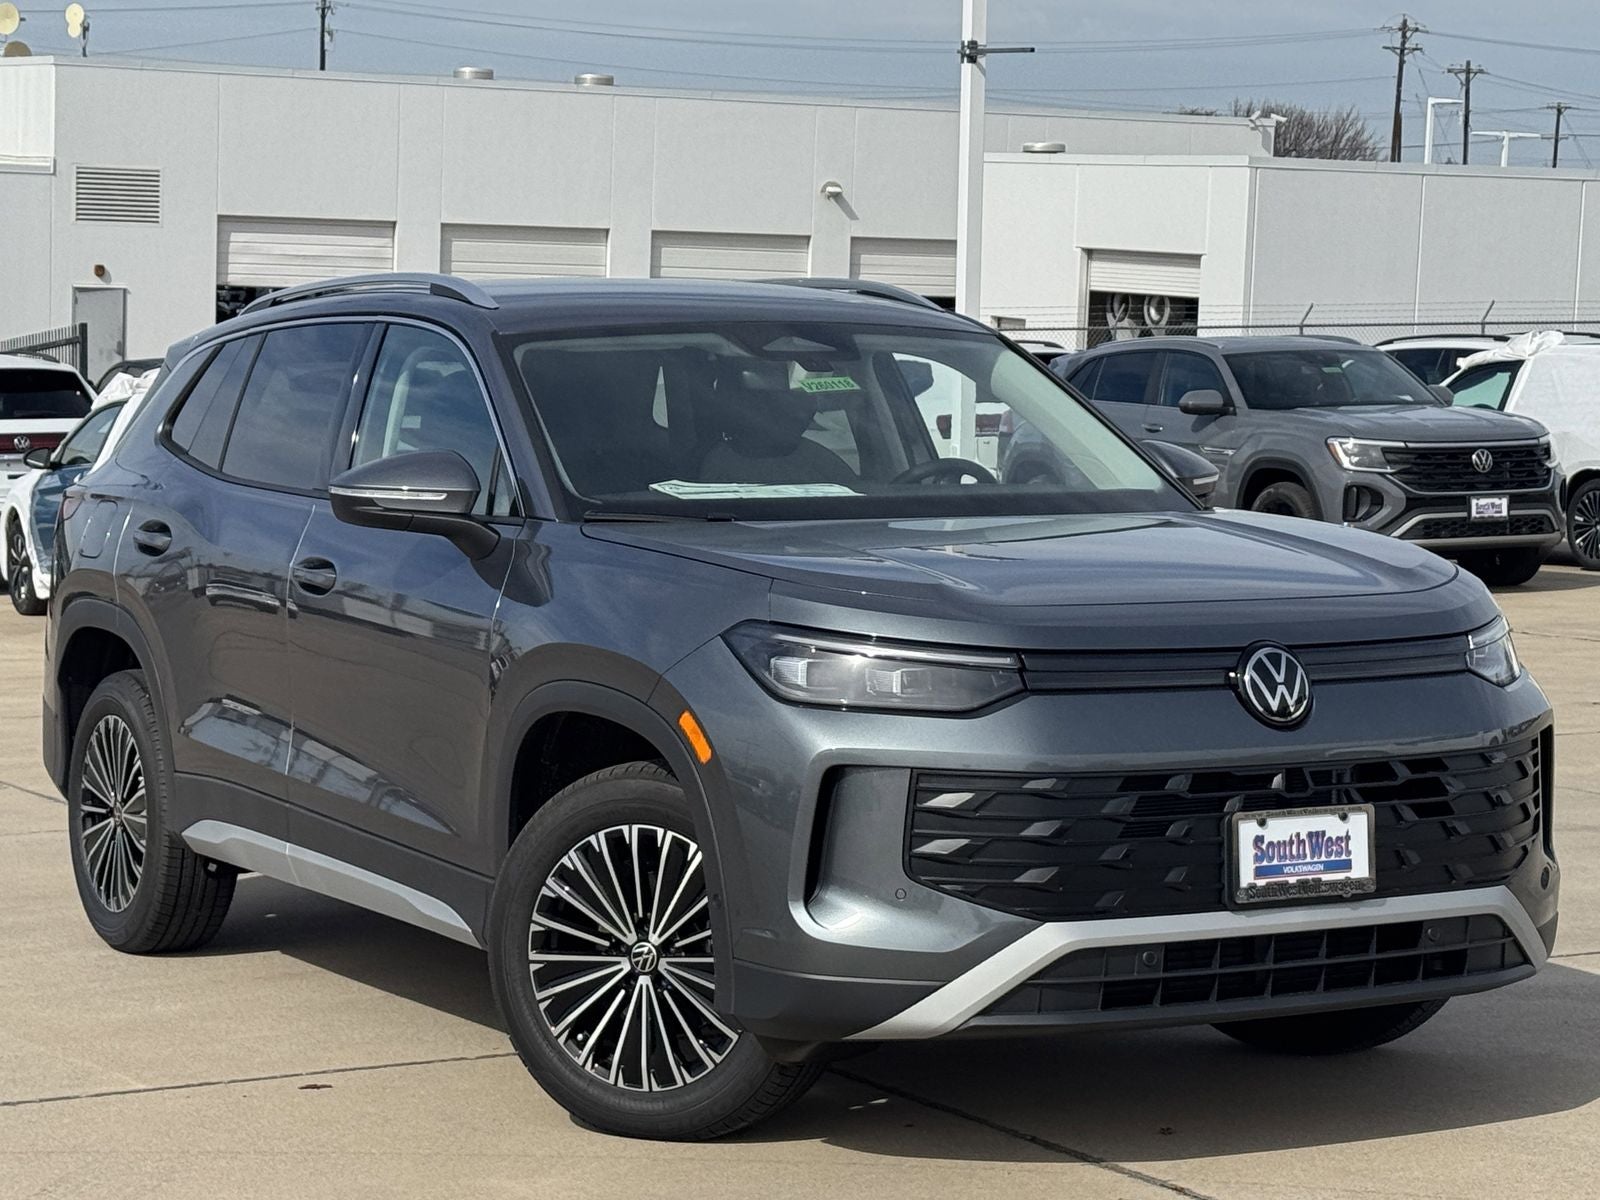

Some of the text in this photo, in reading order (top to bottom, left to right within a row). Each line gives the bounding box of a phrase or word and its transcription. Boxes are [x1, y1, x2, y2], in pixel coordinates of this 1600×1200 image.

[1472, 448, 1493, 473] VW
[1244, 647, 1309, 721] VW
[1283, 863, 1324, 874] VOLKSWAGEN
